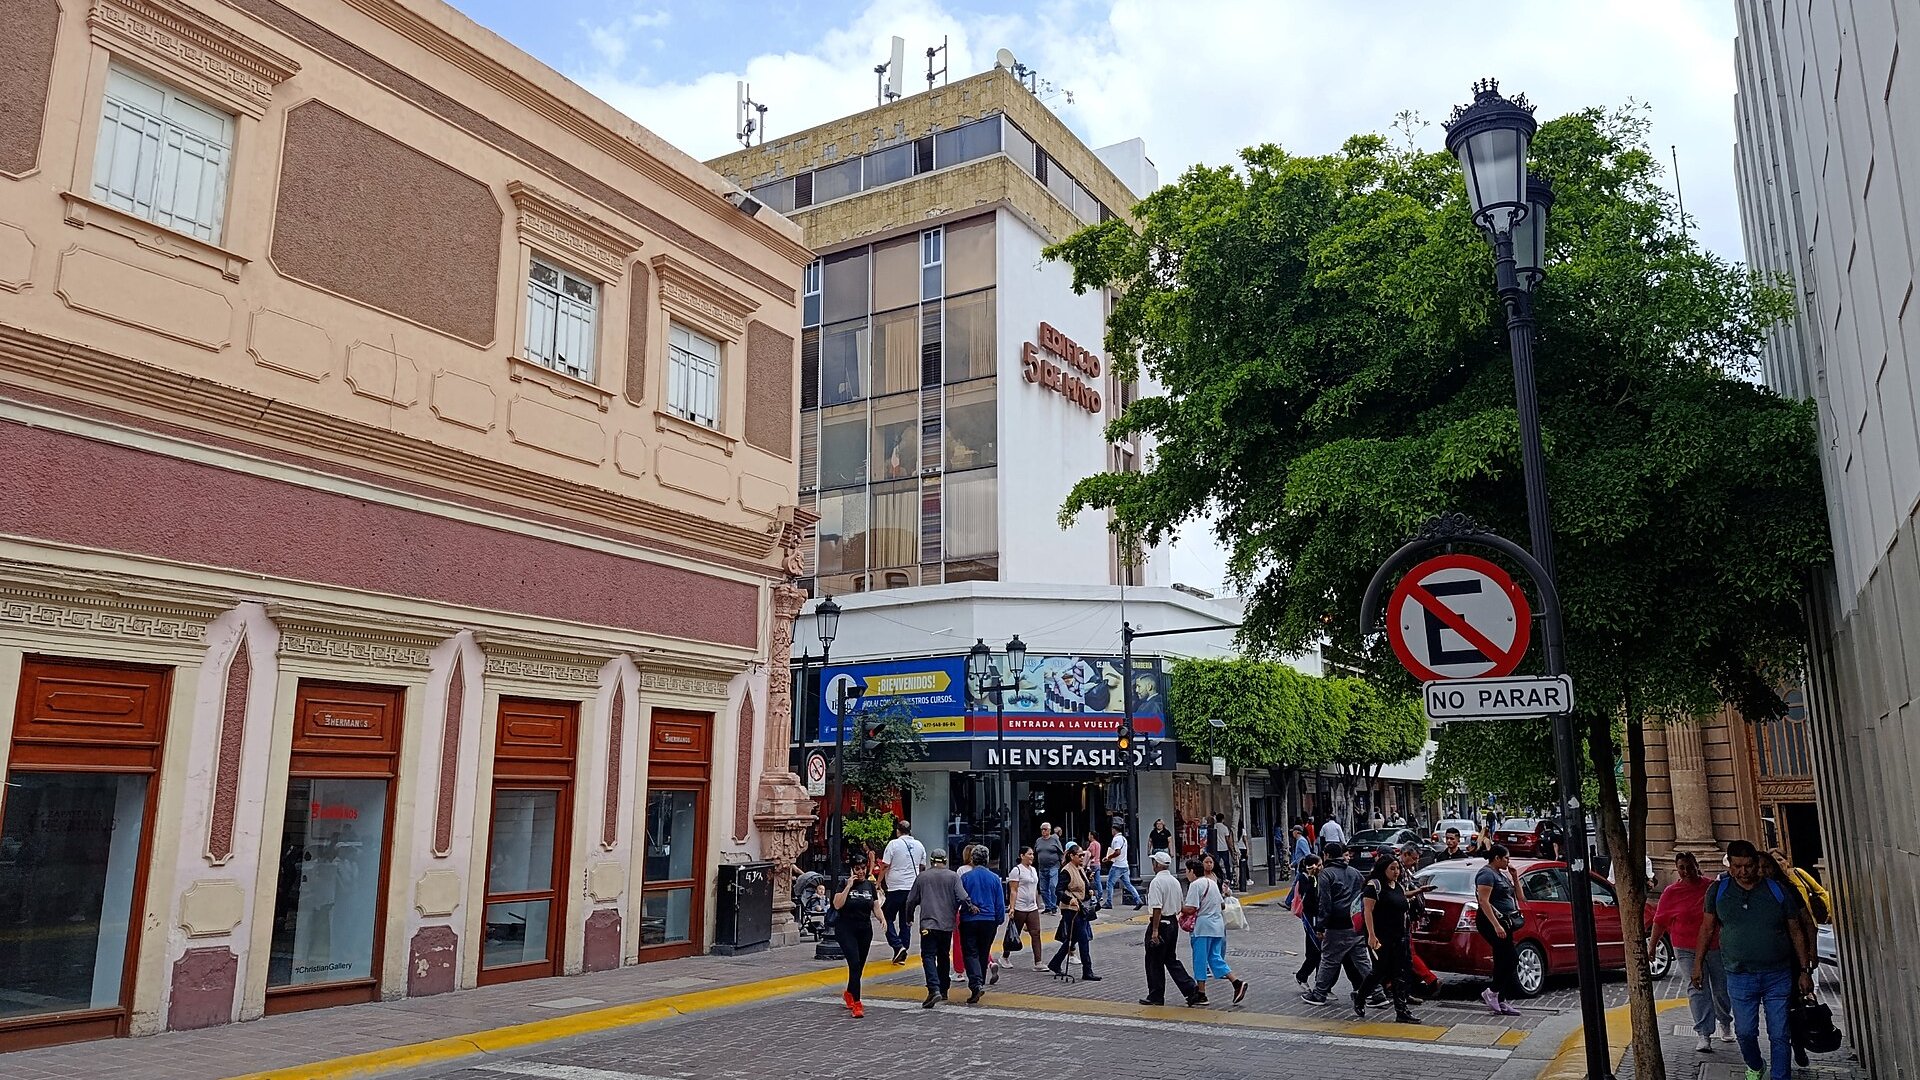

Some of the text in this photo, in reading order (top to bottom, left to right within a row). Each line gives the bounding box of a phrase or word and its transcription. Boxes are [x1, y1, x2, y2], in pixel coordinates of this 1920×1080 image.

[1040, 321, 1101, 378] EDIFICIO
[1023, 341, 1102, 414] 5 DE MAYO
[877, 675, 936, 695] ¡BIENVENIDOS!
[1432, 687, 1562, 710] NO PARAR
[1009, 720, 1121, 728] ENTRADA A LA VUELTA
[294, 962, 353, 974] #ChristianGallery
